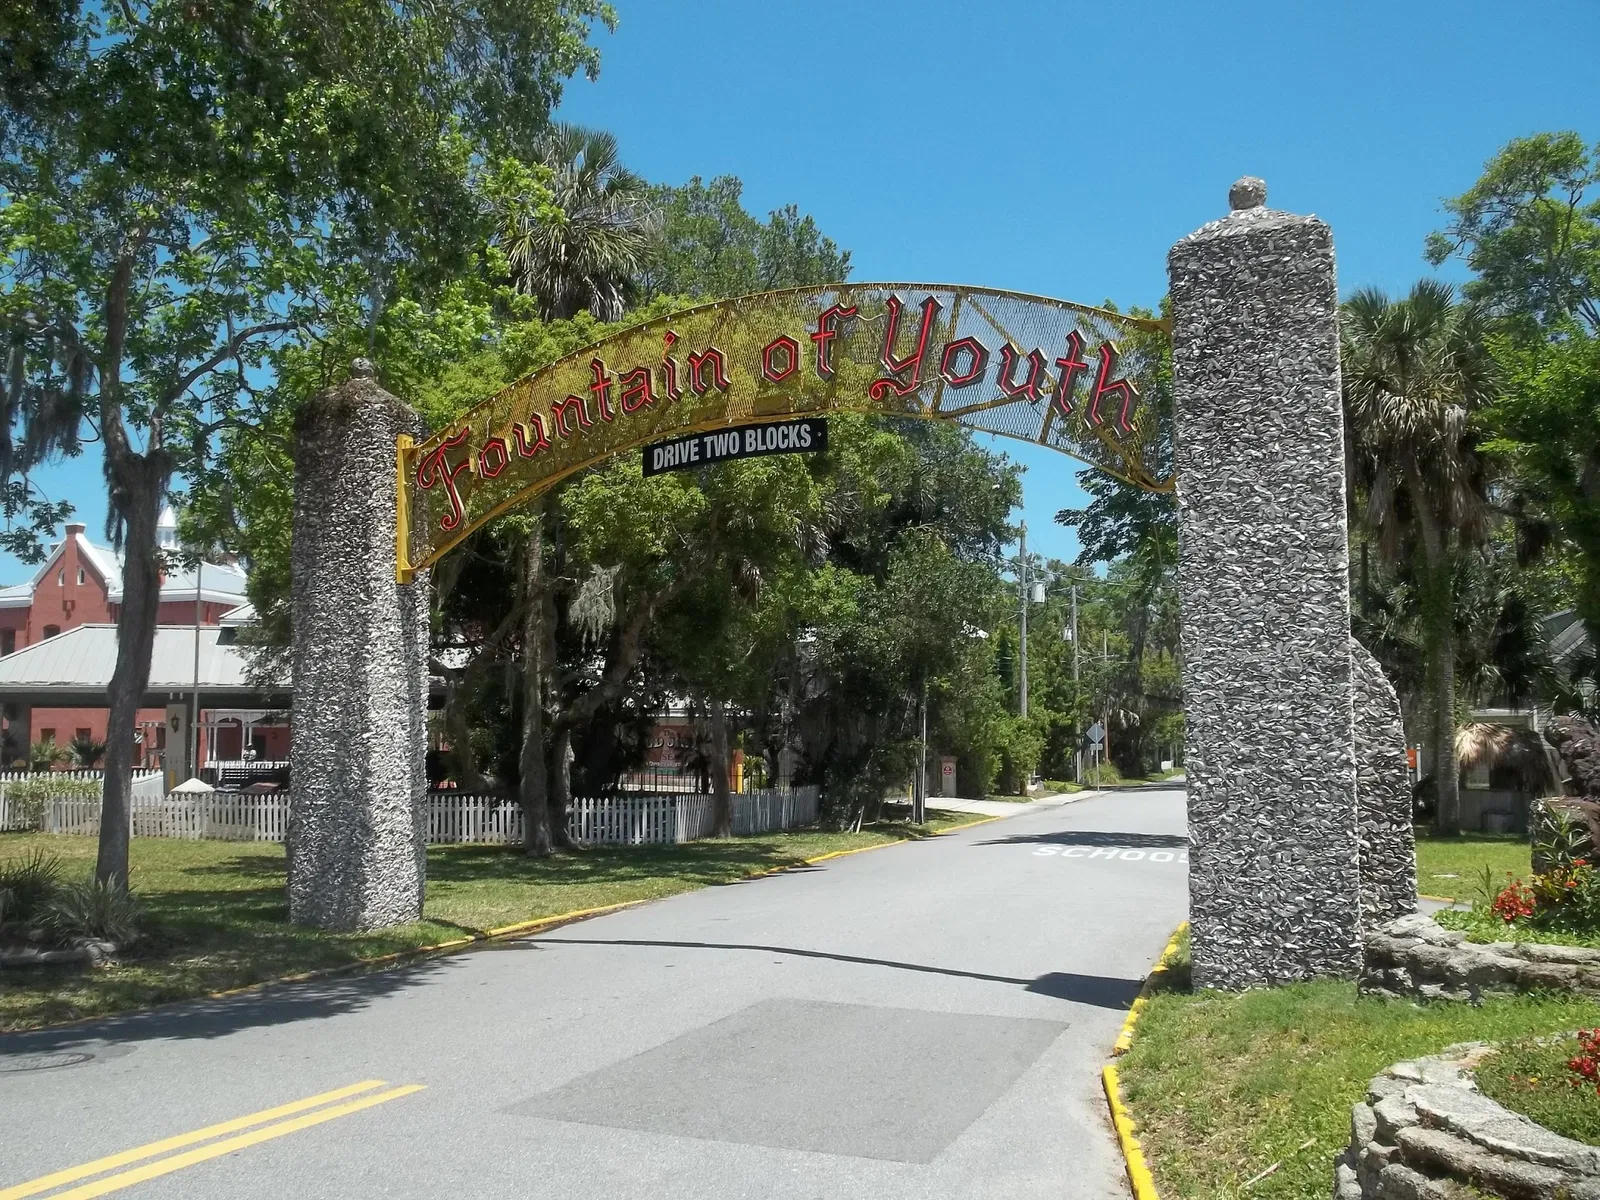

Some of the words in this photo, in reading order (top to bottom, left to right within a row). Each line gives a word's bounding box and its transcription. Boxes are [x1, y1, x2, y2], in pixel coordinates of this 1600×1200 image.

[415, 329, 732, 532] Fountain
[760, 302, 858, 384] of
[868, 293, 1141, 439] Youth
[653, 438, 699, 470] DRIVE
[704, 431, 740, 459] TWO
[745, 424, 812, 453] BLOCKS
